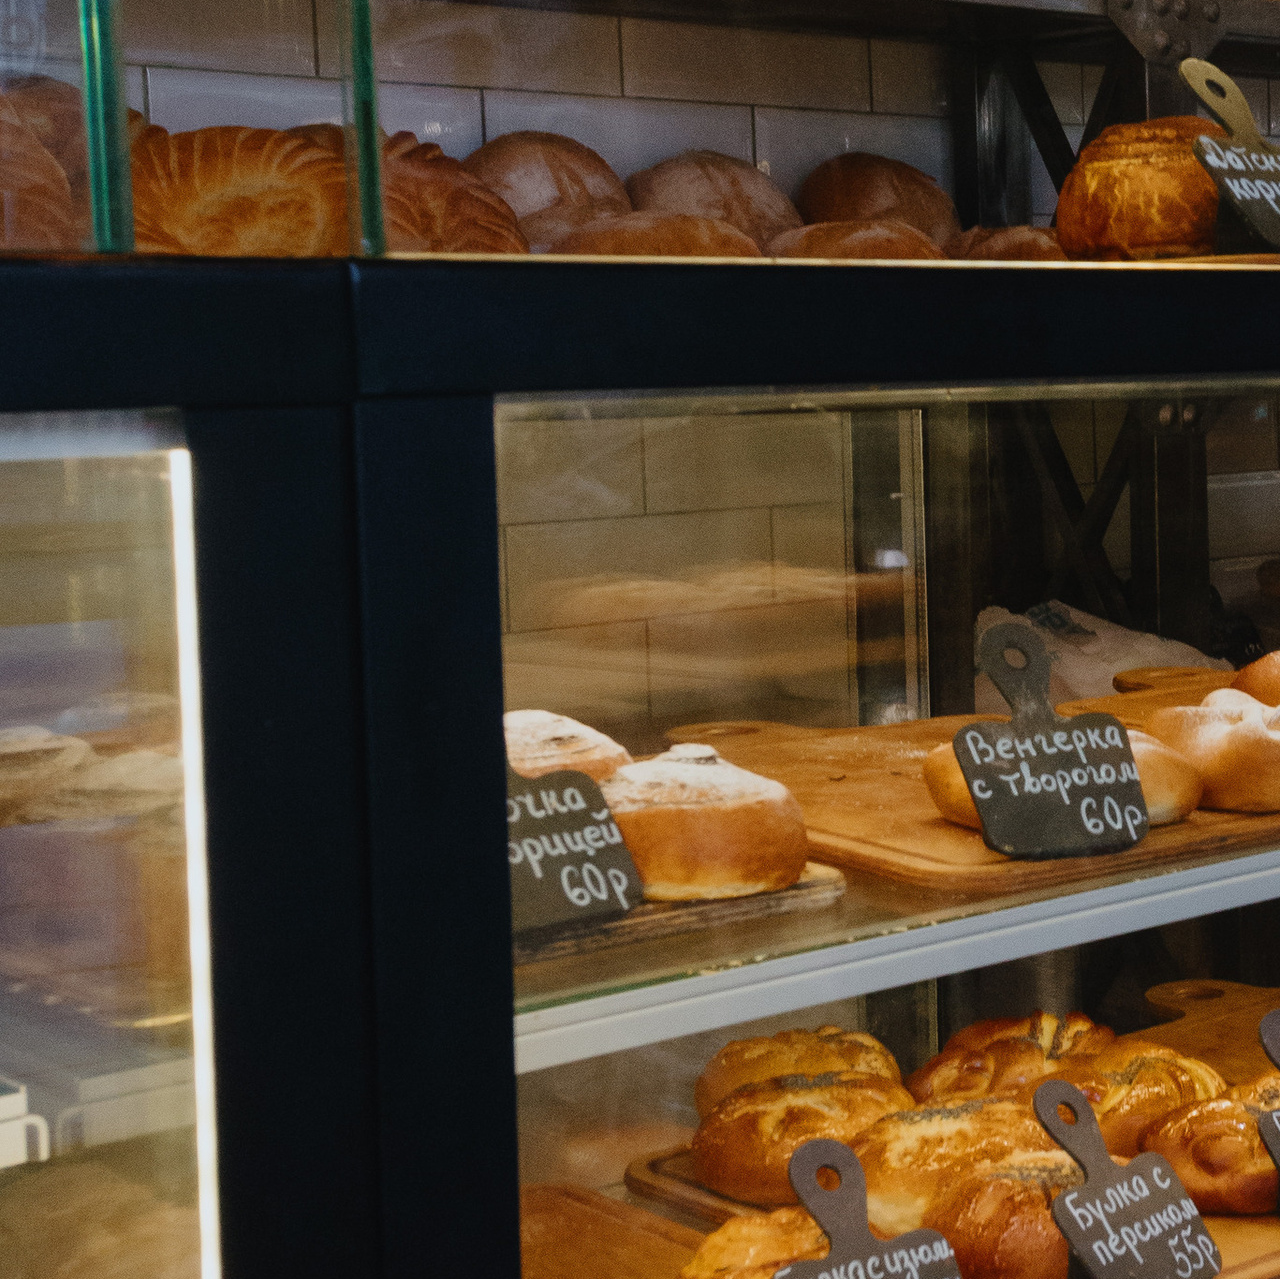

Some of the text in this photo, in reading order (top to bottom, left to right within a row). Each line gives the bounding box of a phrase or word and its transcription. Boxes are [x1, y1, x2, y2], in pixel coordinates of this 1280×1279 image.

[965, 725, 1124, 765] Венгерка
[972, 761, 1140, 805] с творогом
[560, 863, 630, 910] 60р
[1065, 1167, 1171, 1235] Булка с
[1092, 1197, 1200, 1267] персиком
